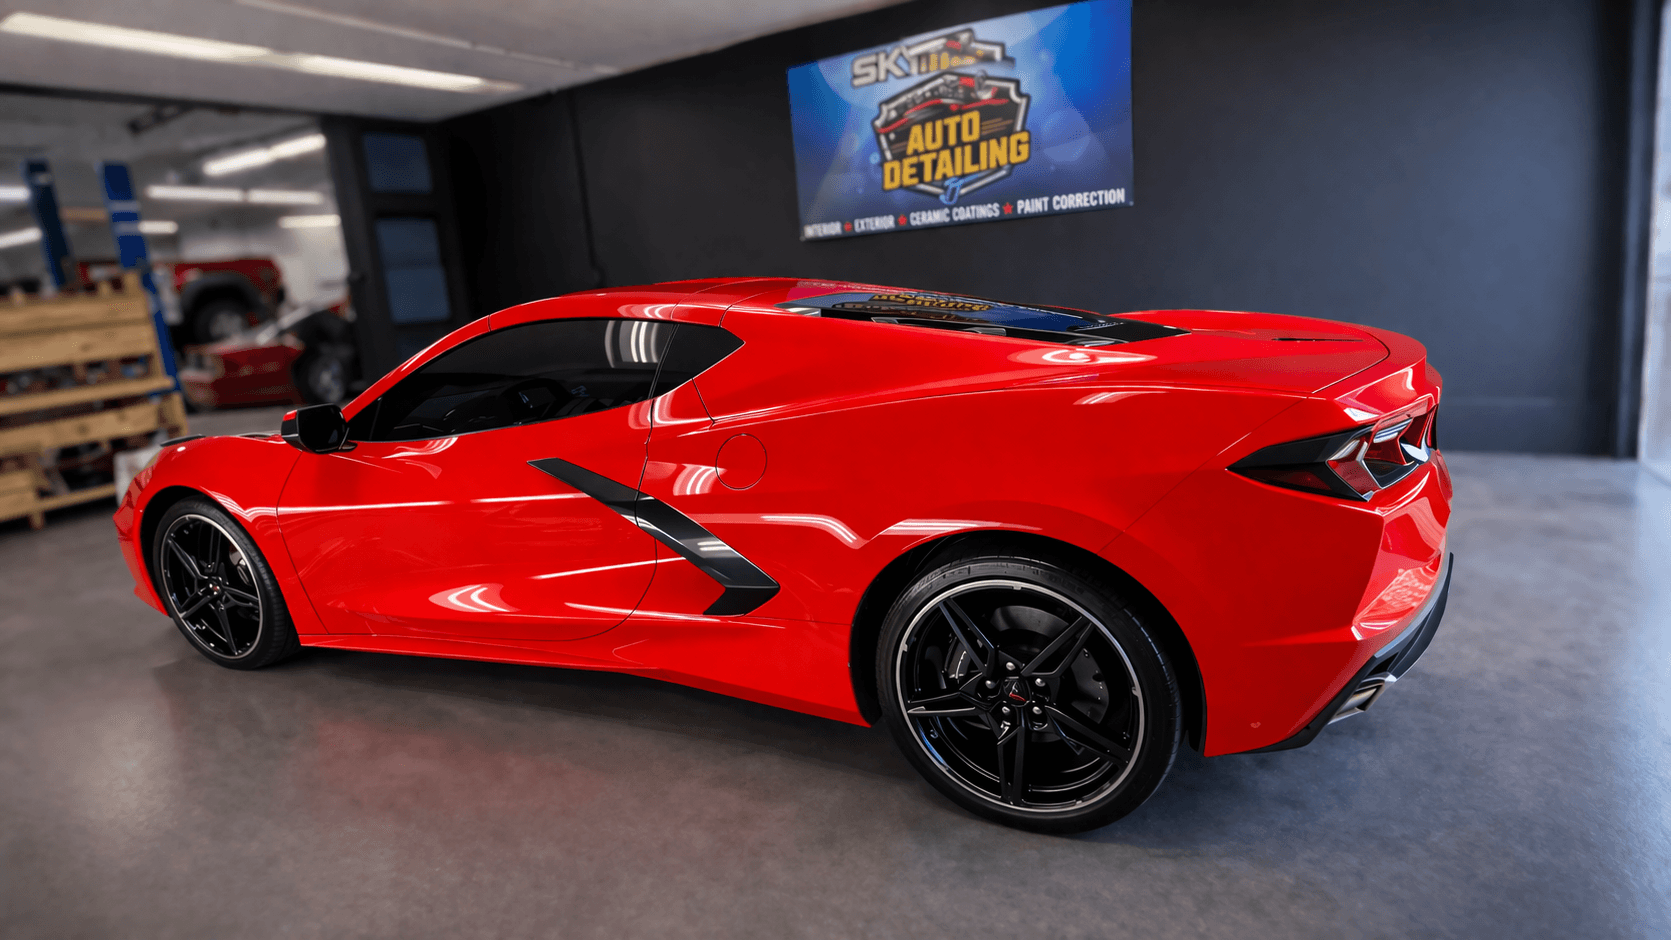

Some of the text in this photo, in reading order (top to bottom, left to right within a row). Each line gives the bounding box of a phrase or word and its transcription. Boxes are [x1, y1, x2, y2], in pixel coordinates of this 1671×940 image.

[906, 110, 981, 155] AUTO
[883, 131, 1030, 190] DETAILING
[854, 214, 895, 233] EXTERIOR
[909, 207, 950, 226] CERAMIC
[952, 202, 1000, 221] COATINGS
[1016, 197, 1049, 214] PAINT
[1052, 188, 1125, 210] CORRECTION
